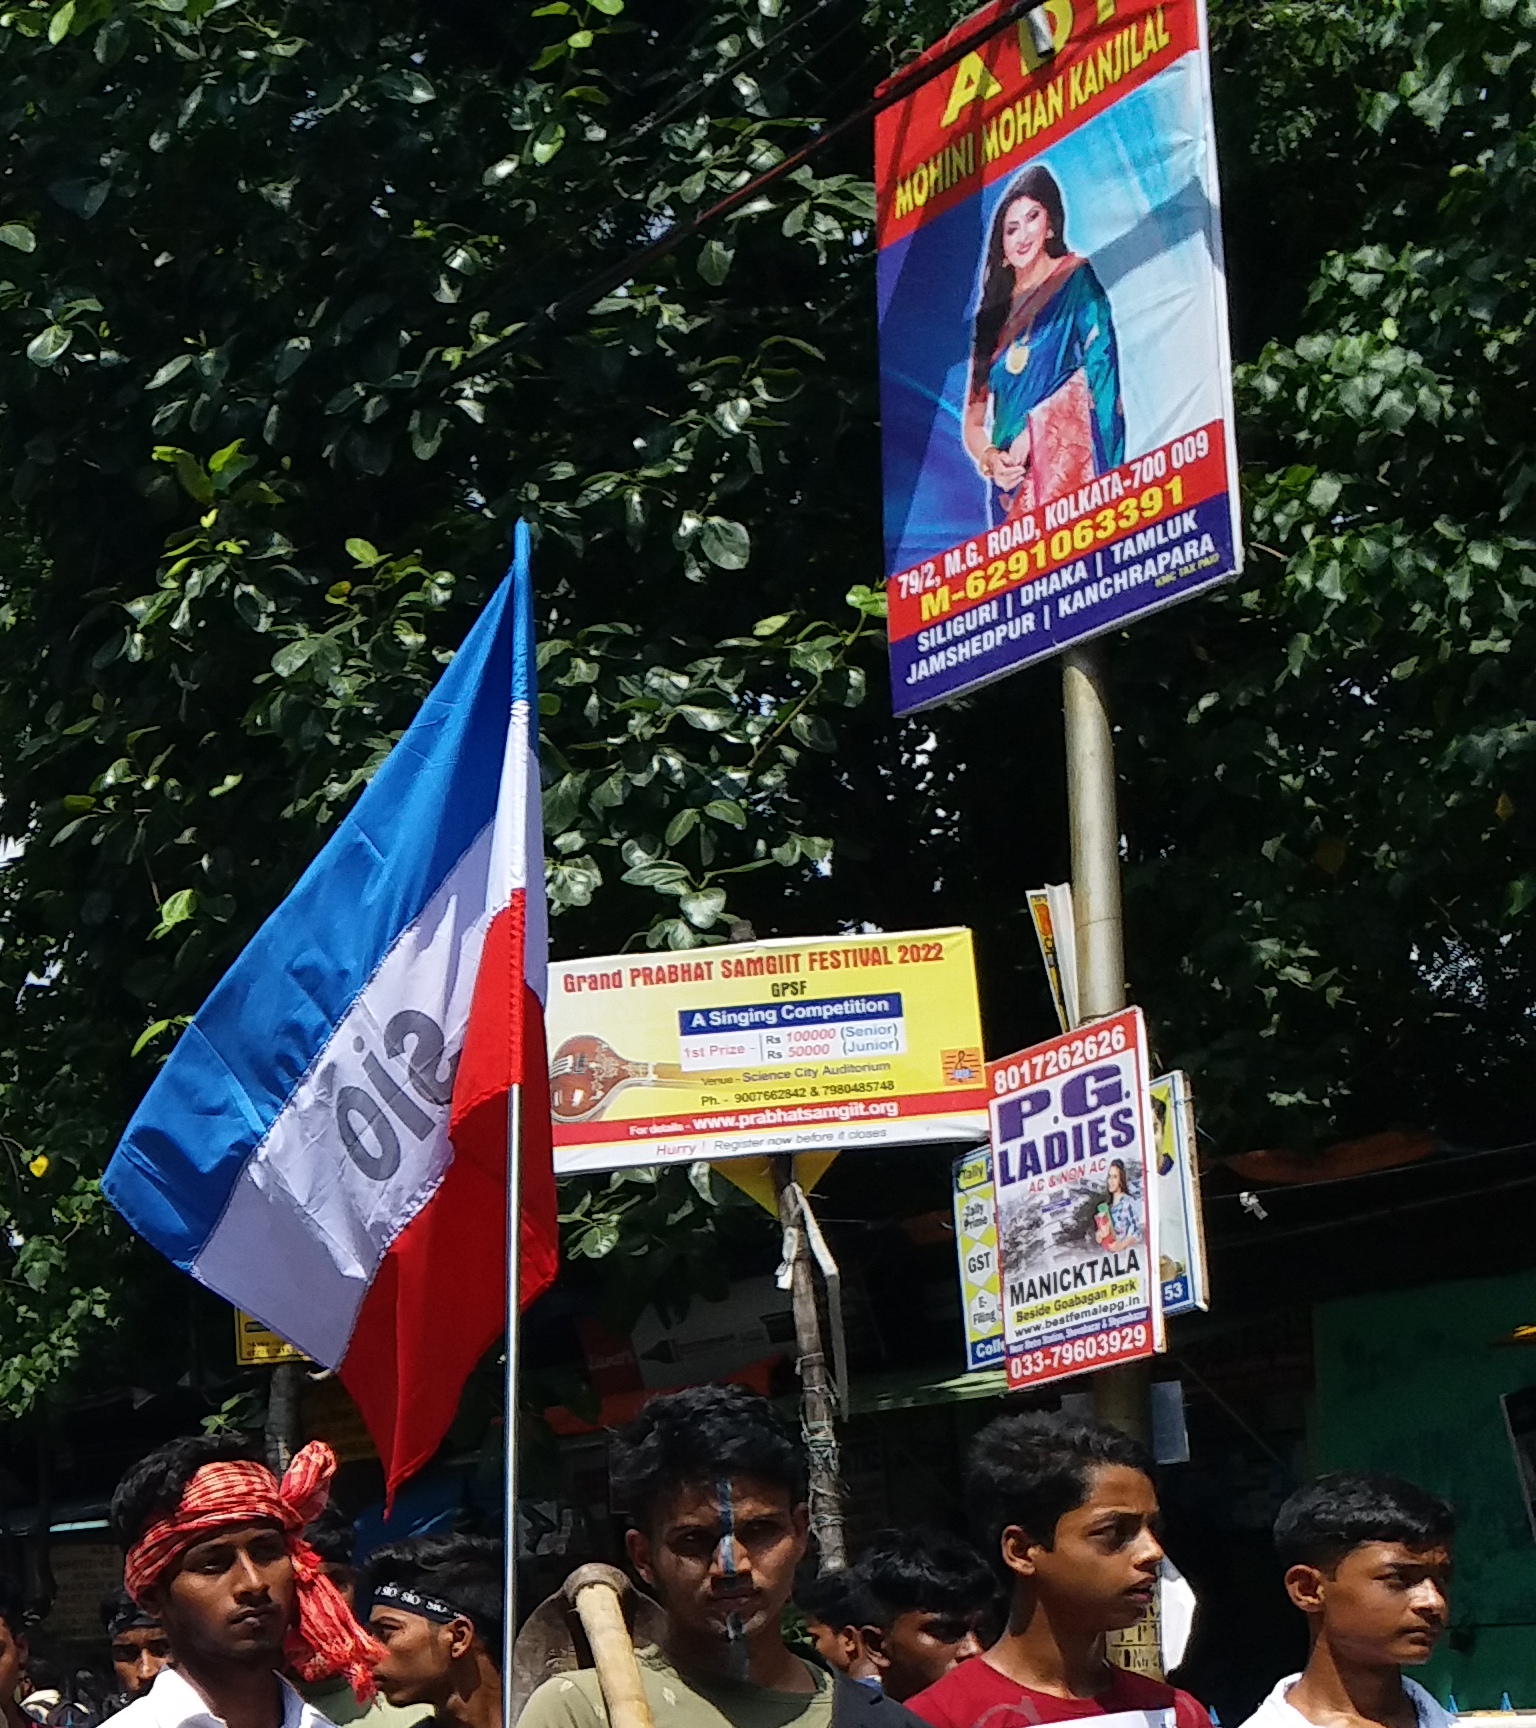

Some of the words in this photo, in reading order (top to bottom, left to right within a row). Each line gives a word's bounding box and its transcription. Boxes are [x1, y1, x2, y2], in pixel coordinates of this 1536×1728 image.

[895, 132, 975, 220] MOHINI
[981, 76, 1064, 166] MOHAN
[1069, 5, 1170, 110] KANJILAL
[897, 562, 941, 599] 79/2,
[944, 540, 984, 578] M.G.
[987, 515, 1041, 557] ROAD,
[1045, 457, 1166, 530] KOLKATA-700
[1170, 430, 1209, 468] 009
[920, 475, 1184, 622] M-6291063391
[917, 600, 998, 652] SILIGURI
[1020, 560, 1088, 607] DHAKA
[1111, 509, 1199, 564] TAMLUK
[905, 612, 1035, 685] JAMSHEDPUR
[1058, 533, 1215, 619] KANCHRAPARA
[563, 968, 623, 993] Grand
[630, 961, 714, 988] PRABHAT
[721, 953, 801, 979] SAMGIIT
[809, 947, 894, 971] FESTIVAL
[898, 943, 945, 964] 2022
[771, 981, 808, 998] GPSF
[691, 1012, 705, 1028] A
[708, 1007, 778, 1030] Singing
[781, 997, 890, 1022] Competition
[684, 1045, 705, 1059] 1st
[708, 1042, 746, 1057] Prize
[766, 1034, 782, 1045] Rs
[786, 1027, 837, 1043] 100000
[840, 1023, 898, 1042] (Senior)
[767, 1048, 783, 1060] Rs
[787, 1043, 831, 1058] 50000
[843, 1037, 900, 1055] (Junior)
[994, 1025, 1126, 1095] 8017262626
[742, 1069, 792, 1084] Science
[794, 1067, 819, 1080] City
[822, 1061, 891, 1076] Auditorium
[810, 1087, 820, 1097] &
[629, 1125, 647, 1136] For
[692, 1101, 899, 1130] www.prabhatsamgiit.org
[998, 1063, 1132, 1145] P.G.
[656, 1142, 696, 1158] Hurry
[714, 1135, 764, 1151] Register
[767, 1136, 793, 1147] now
[796, 1130, 834, 1144] before
[848, 1128, 888, 1140] closes
[998, 1107, 1135, 1188] LADIES
[1028, 1176, 1046, 1194] AC
[1048, 1174, 1057, 1188] &
[1059, 1164, 1086, 1186] NON
[1089, 1158, 1106, 1175] AC
[968, 1252, 991, 1274] GST
[1009, 1249, 1140, 1308] MANICKTALA
[1014, 1296, 1140, 1338] www.bestfemalepg.in
[1016, 1305, 1051, 1323] Beside
[1054, 1290, 1107, 1311] Goabagan
[1111, 1279, 1137, 1296] Park
[1010, 1324, 1147, 1380] 033-79603929
